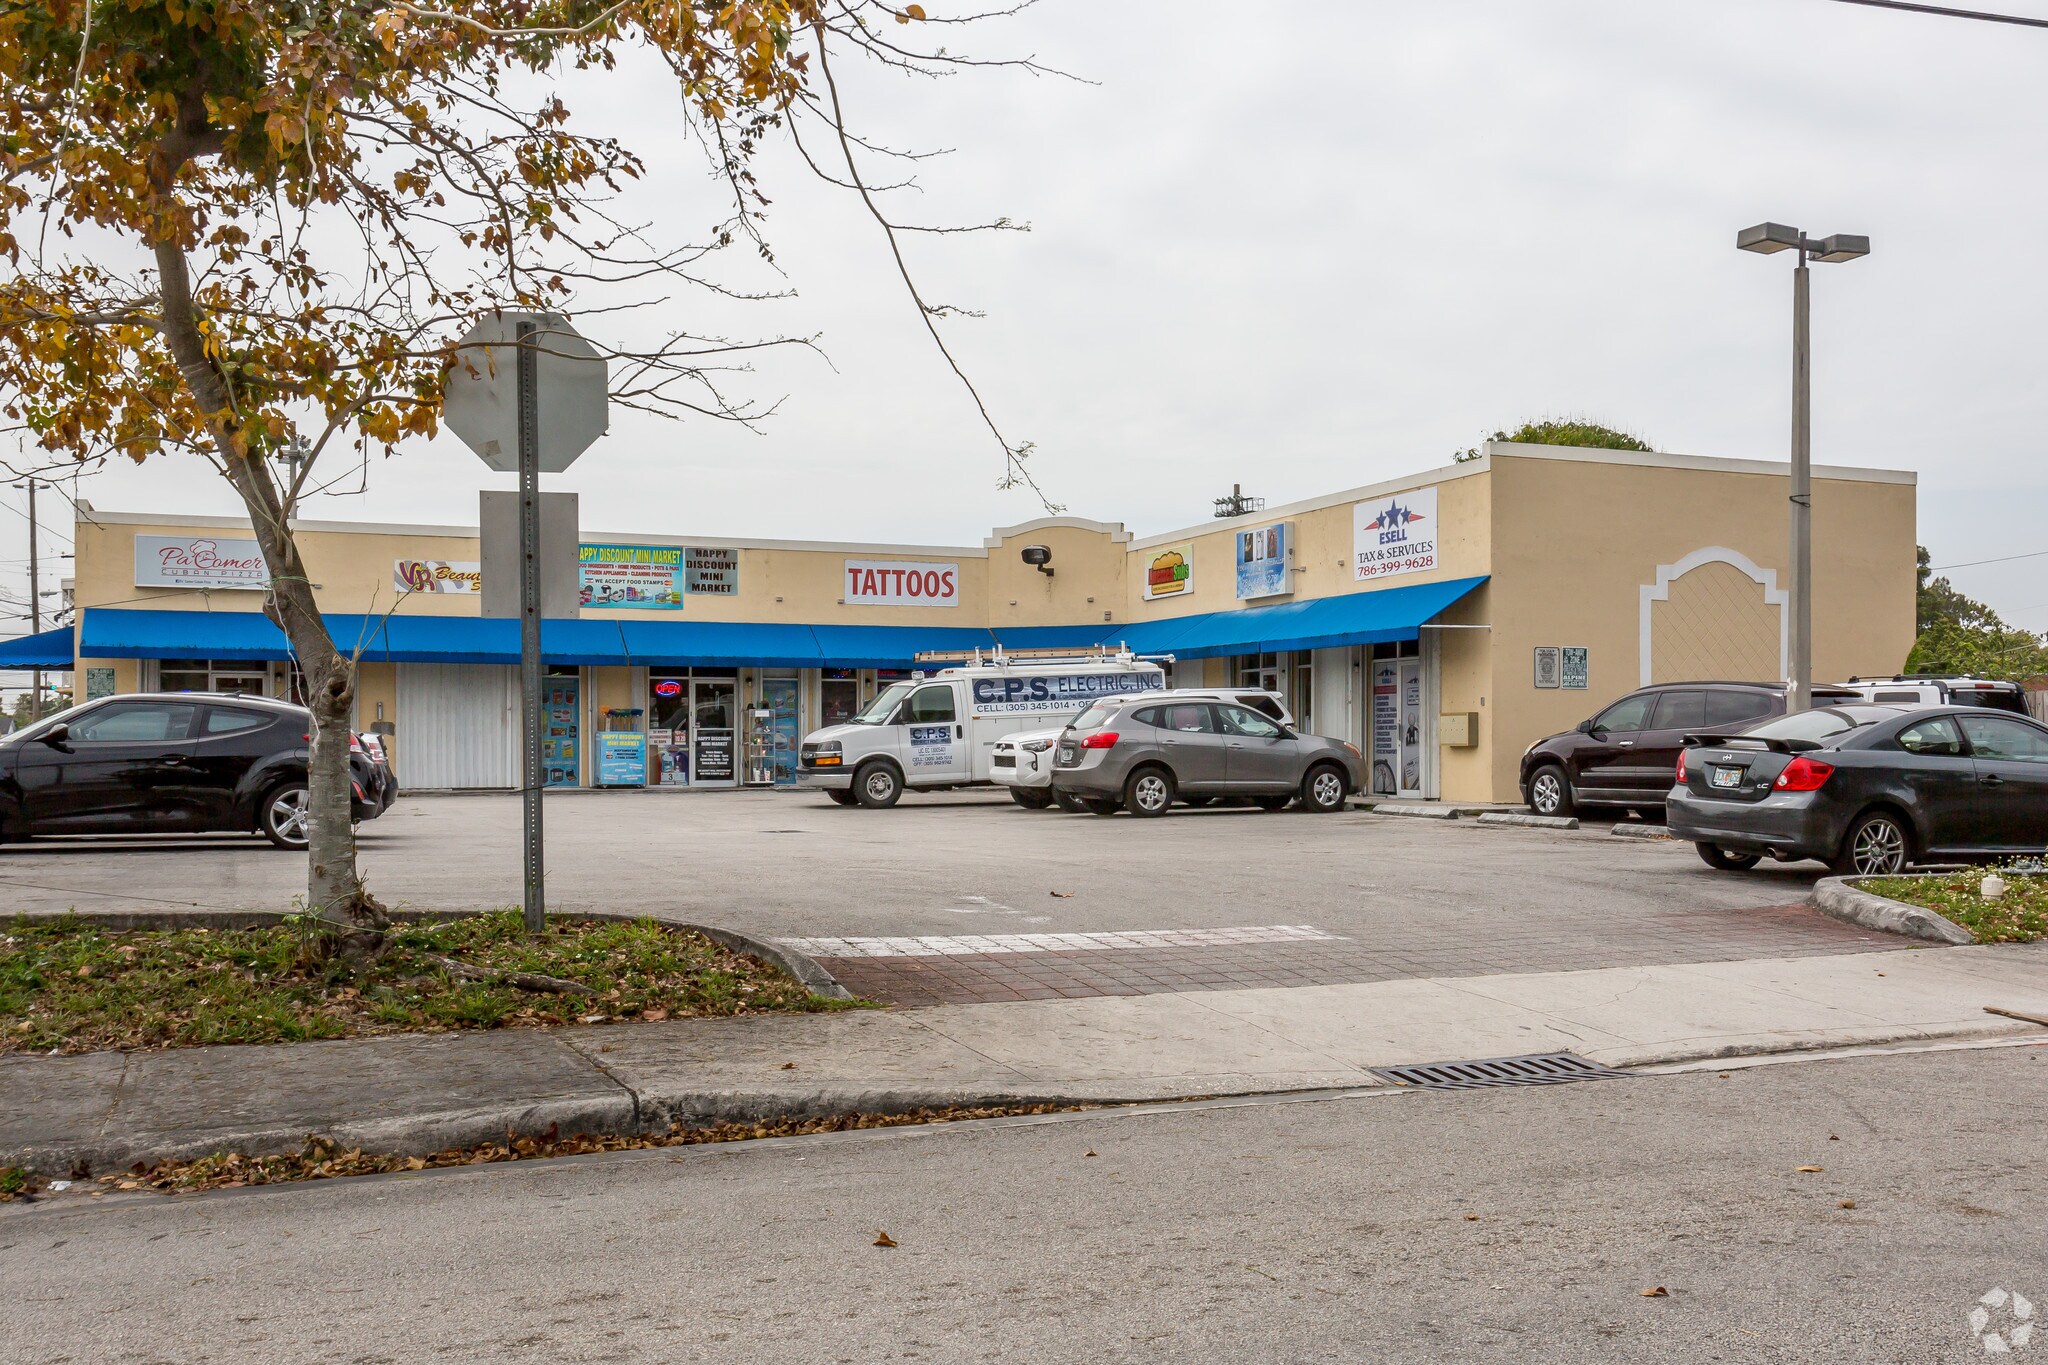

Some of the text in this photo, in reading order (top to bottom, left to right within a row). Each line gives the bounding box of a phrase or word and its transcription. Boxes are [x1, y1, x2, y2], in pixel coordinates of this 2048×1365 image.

[1379, 529, 1407, 545] ESELL
[580, 548, 681, 564] APPY DISCOUNT MINI MARKET
[696, 549, 727, 558] HAPPY
[1358, 540, 1433, 563] TAX & SERVICES
[686, 560, 737, 570] DISCOUNT
[1358, 555, 1433, 577] 786-399-9628
[161, 568, 263, 578] CUBAN PIZZA
[700, 572, 723, 580] MINI
[692, 583, 731, 592] MARKET
[848, 568, 954, 597] TATTOOS
[656, 684, 681, 693] OPEN
[973, 673, 1161, 703] C.P.S. ELECTRIC, INC
[977, 705, 1004, 713] CELL:
[1006, 703, 1028, 711] (305)
[1030, 701, 1070, 710] 345-1014
[912, 727, 950, 739] C.P.S.
[668, 773, 673, 781] 3
